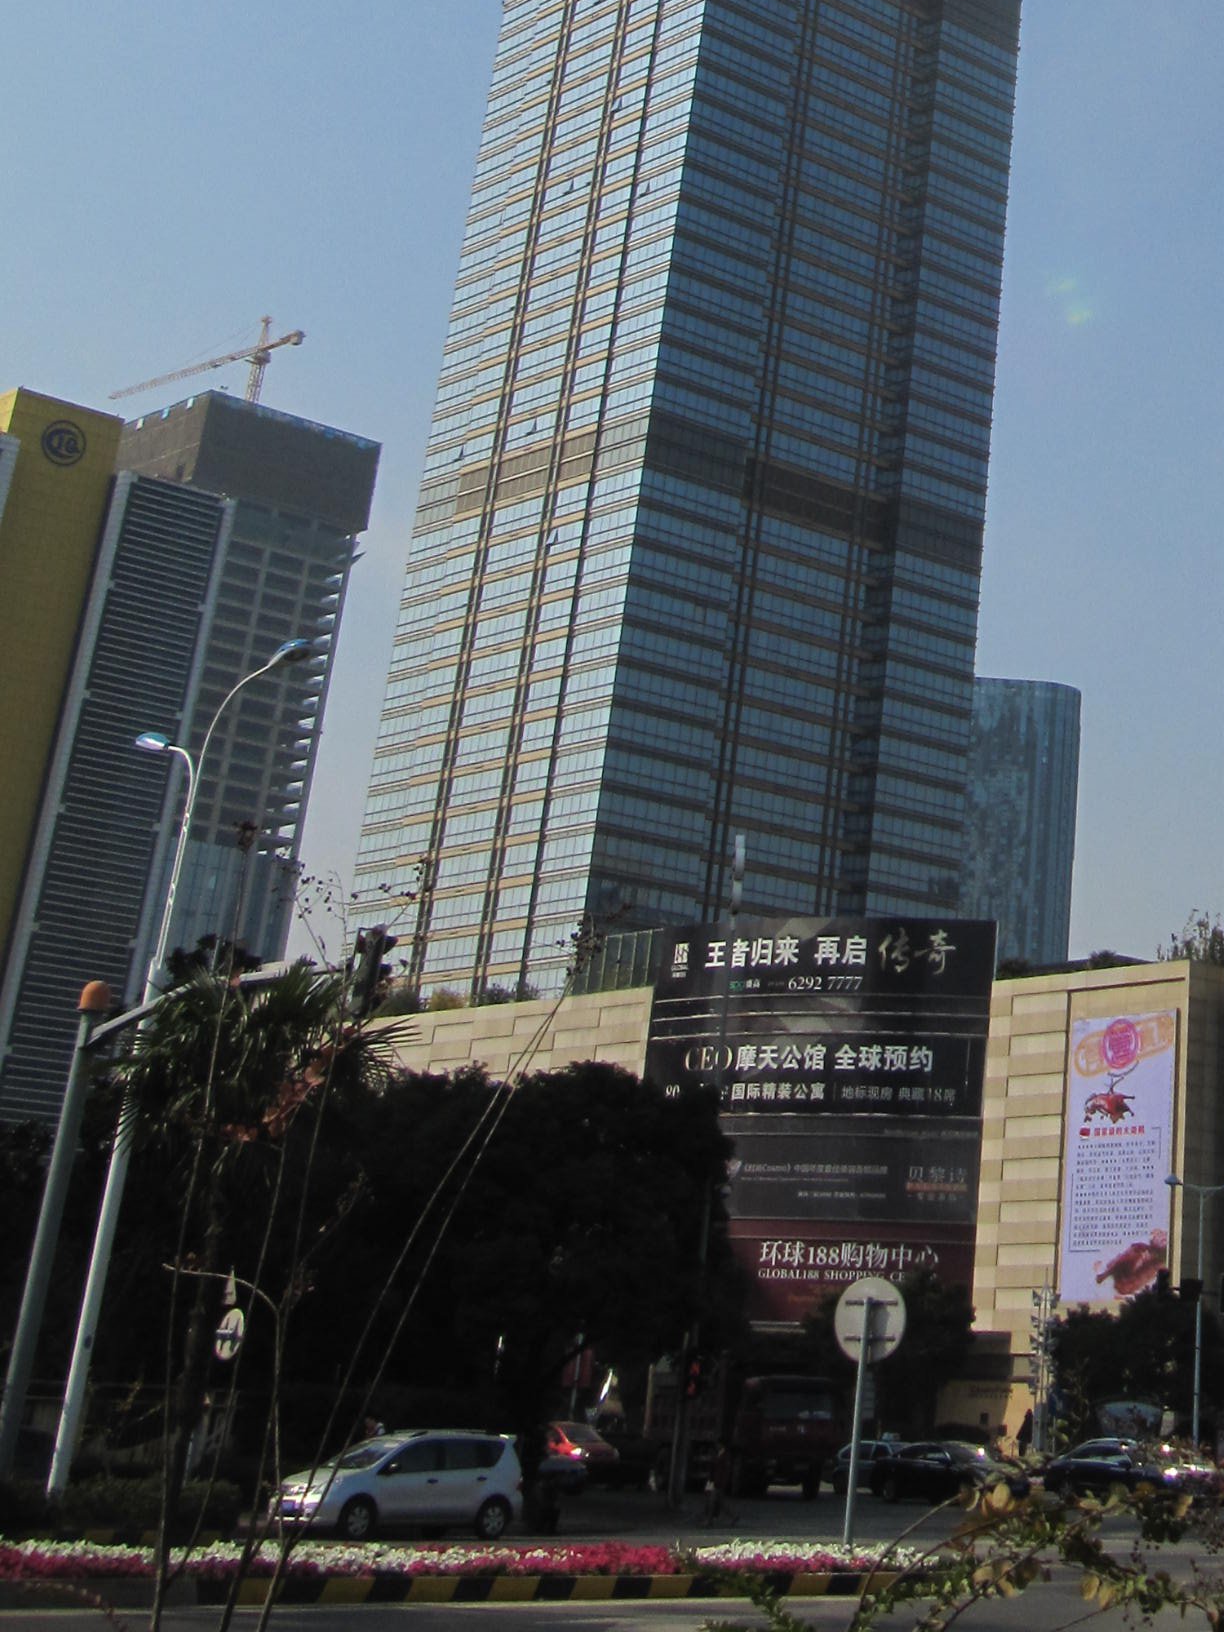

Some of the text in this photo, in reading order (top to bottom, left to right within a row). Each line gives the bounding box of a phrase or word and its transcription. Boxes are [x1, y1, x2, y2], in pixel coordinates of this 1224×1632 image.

[705, 927, 956, 975] 王者归来 再启 传奇
[788, 976, 822, 990] 6292
[827, 976, 863, 990] 7777
[834, 1043, 933, 1072] 全球预约
[731, 1082, 826, 1100] 国际精装公寓
[759, 1240, 939, 1270] 环球188购物中心
[758, 1268, 819, 1280] GLOBAL188
